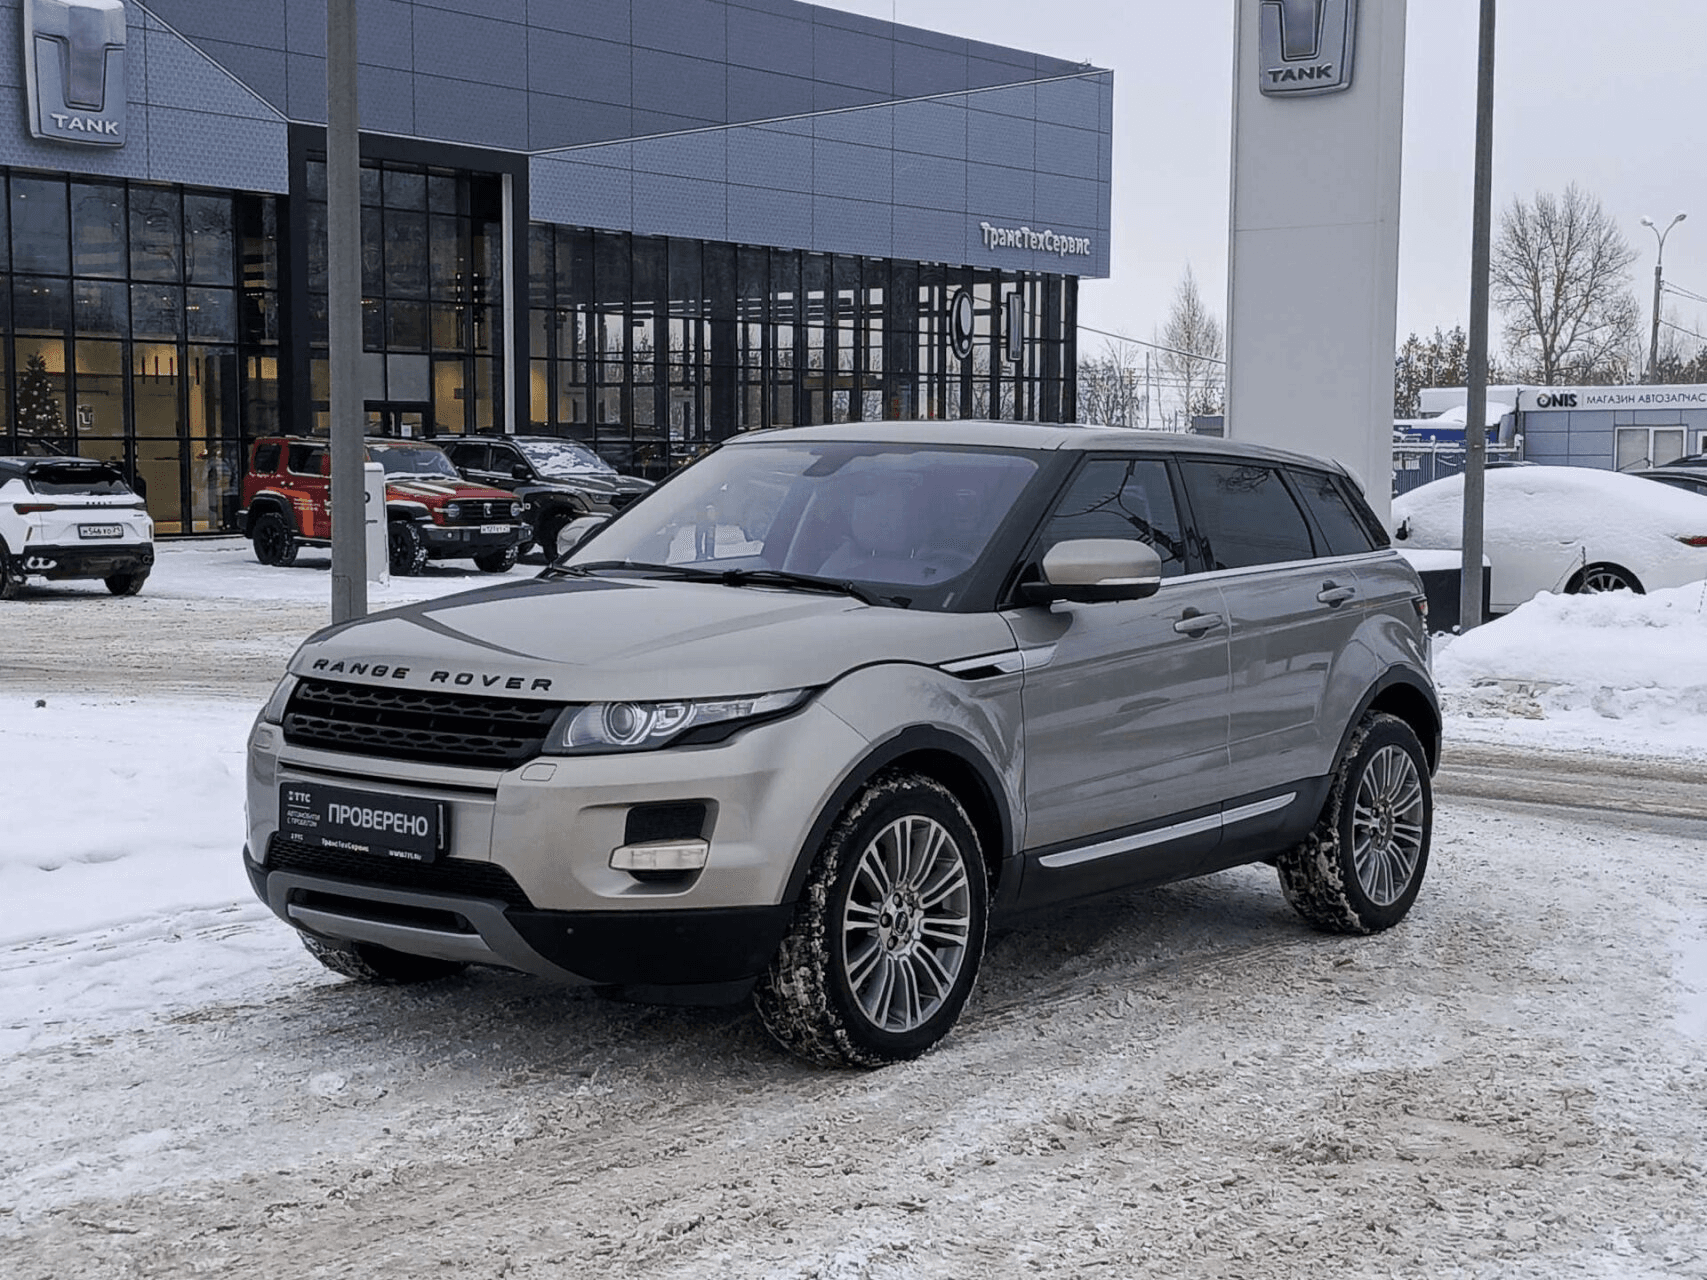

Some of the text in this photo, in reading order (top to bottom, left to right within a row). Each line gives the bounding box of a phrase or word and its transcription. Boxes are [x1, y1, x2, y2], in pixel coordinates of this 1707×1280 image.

[1267, 62, 1332, 83] TANK
[50, 113, 119, 136] TANK
[980, 222, 1091, 257] ТрансТехСервис
[1586, 394, 1635, 404] МАГАЗИН
[312, 659, 552, 691] RANGE ROVER
[328, 803, 428, 836] ПРОВЕРЕНО
